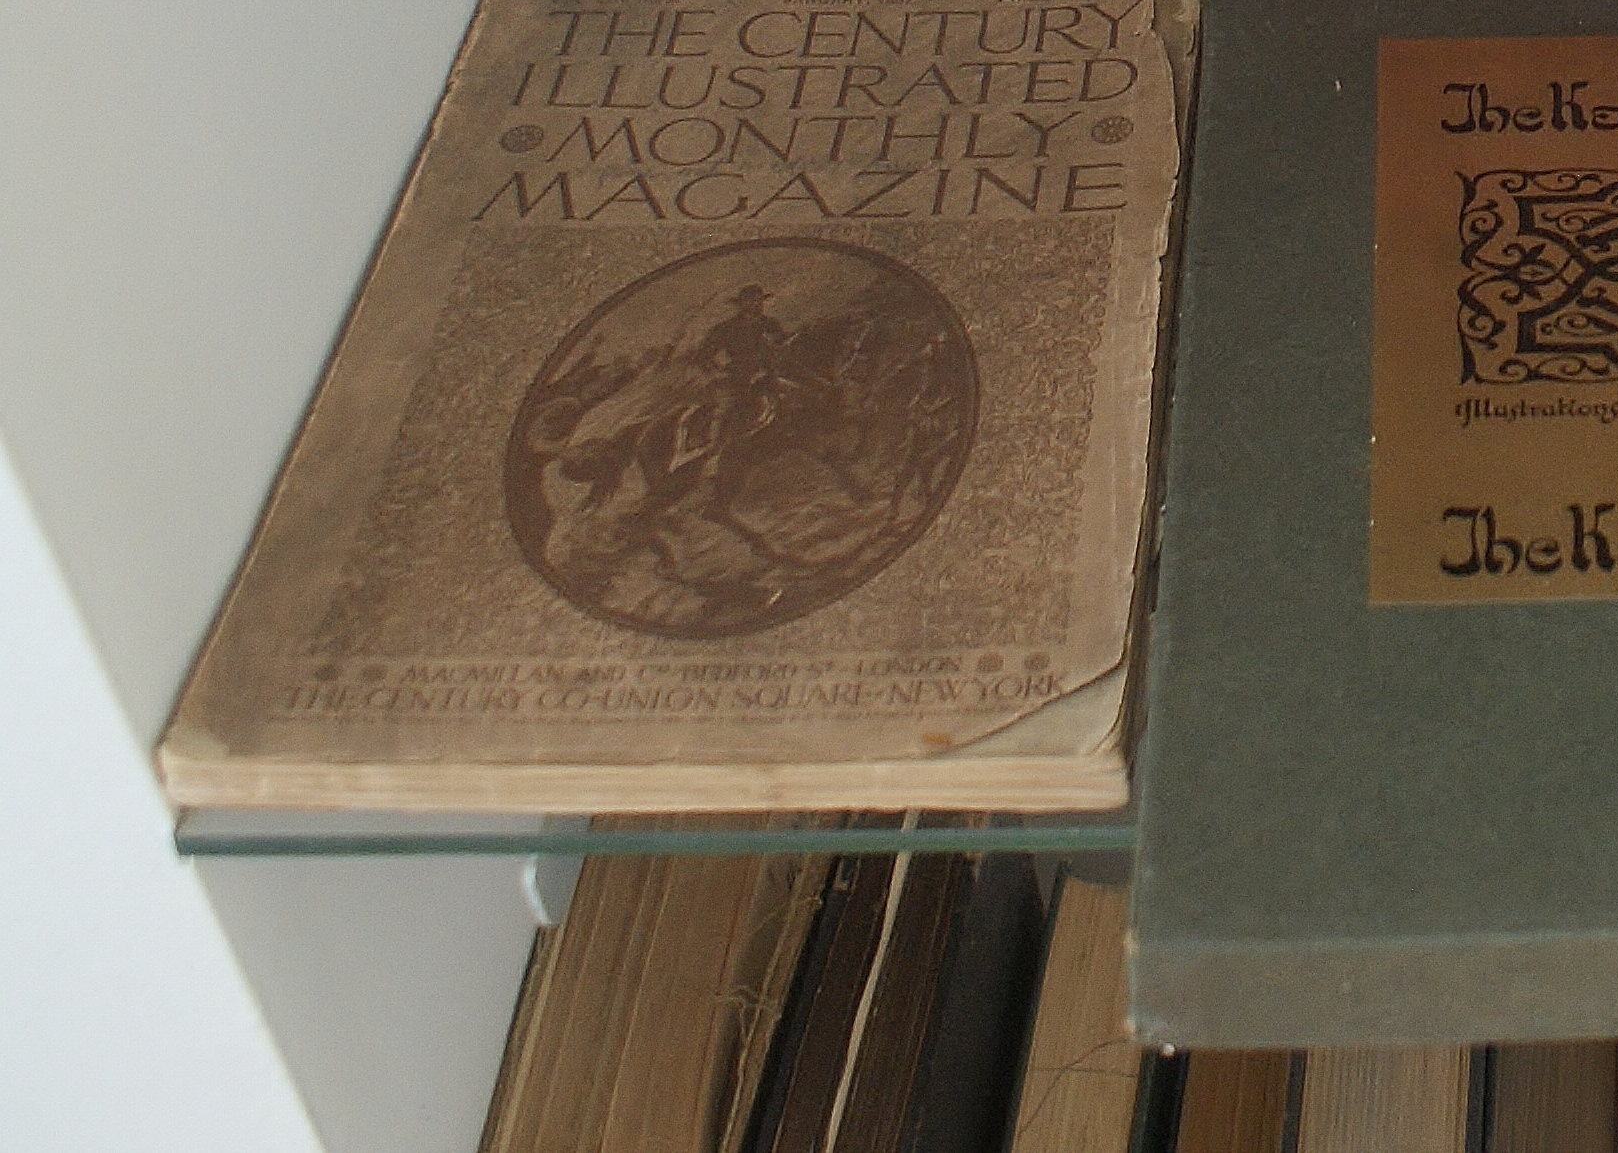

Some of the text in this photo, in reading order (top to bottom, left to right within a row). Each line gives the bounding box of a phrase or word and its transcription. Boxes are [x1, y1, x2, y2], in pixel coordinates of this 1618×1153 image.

[548, 10, 719, 58] THE
[510, 57, 1140, 112] ILLUSTRATED
[546, 110, 1083, 167] MONTHLY
[473, 161, 1130, 222] MAGAZINE
